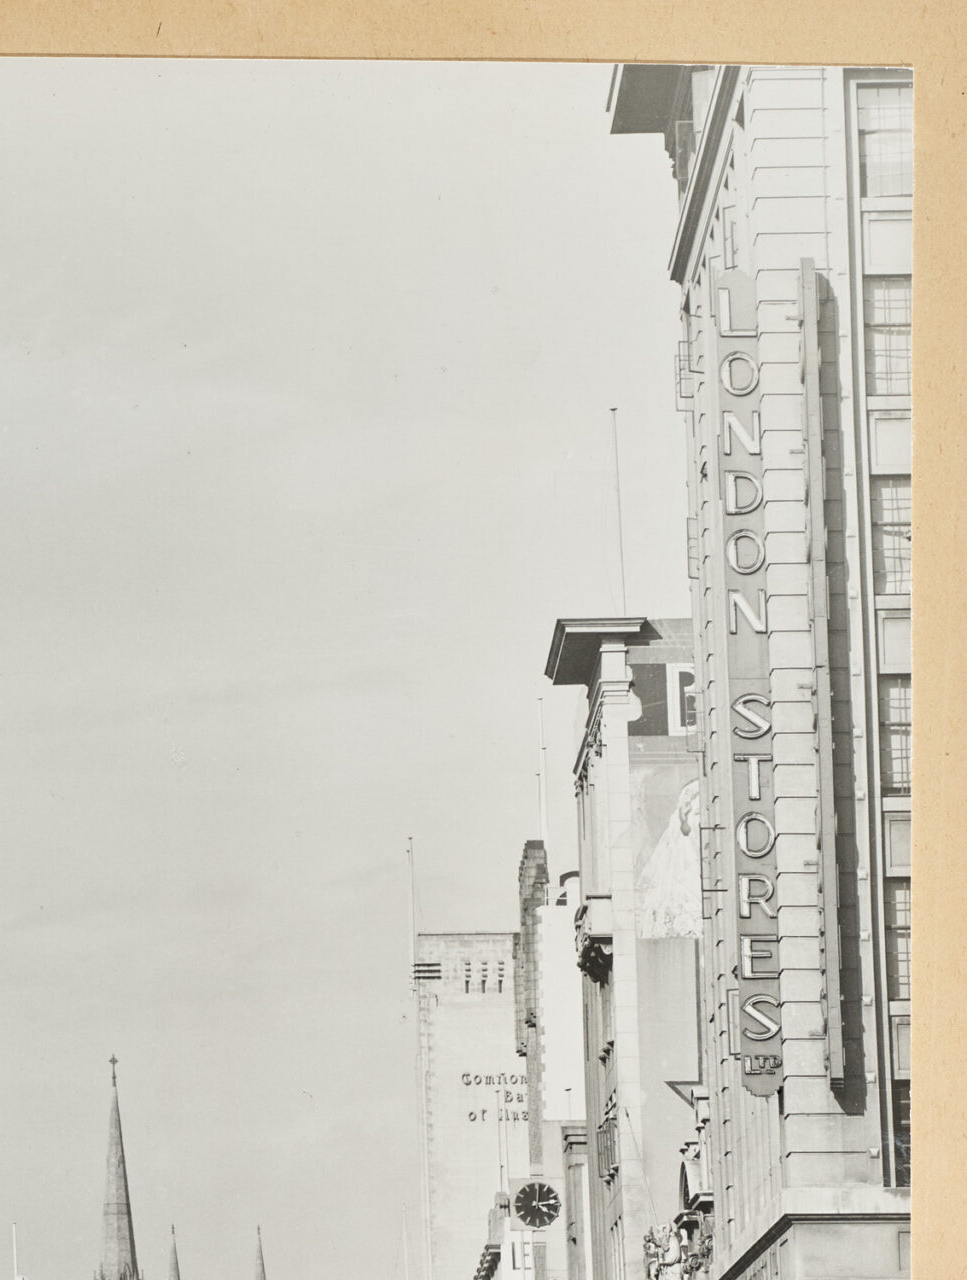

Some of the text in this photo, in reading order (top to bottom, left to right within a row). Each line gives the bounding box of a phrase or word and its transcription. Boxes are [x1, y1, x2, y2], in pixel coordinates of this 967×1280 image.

[718, 287, 782, 1076] LONDON STORES LTD
